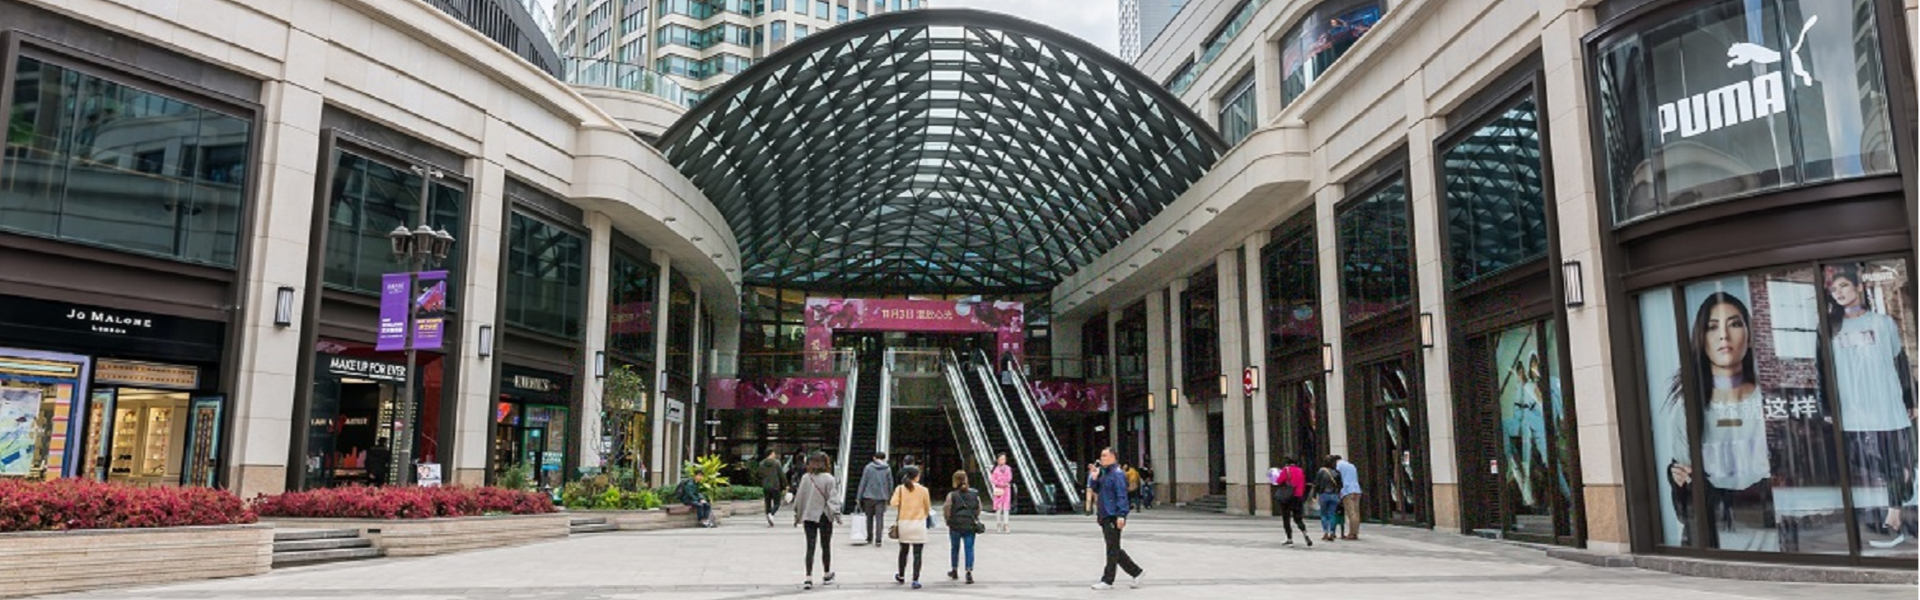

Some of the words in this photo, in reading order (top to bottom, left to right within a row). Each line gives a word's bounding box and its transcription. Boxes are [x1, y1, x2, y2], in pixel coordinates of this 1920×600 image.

[1658, 70, 1786, 144] PUMA
[329, 357, 356, 371] MAKE
[357, 360, 369, 372] UP
[369, 362, 386, 374] FOR
[387, 364, 406, 376] EVER
